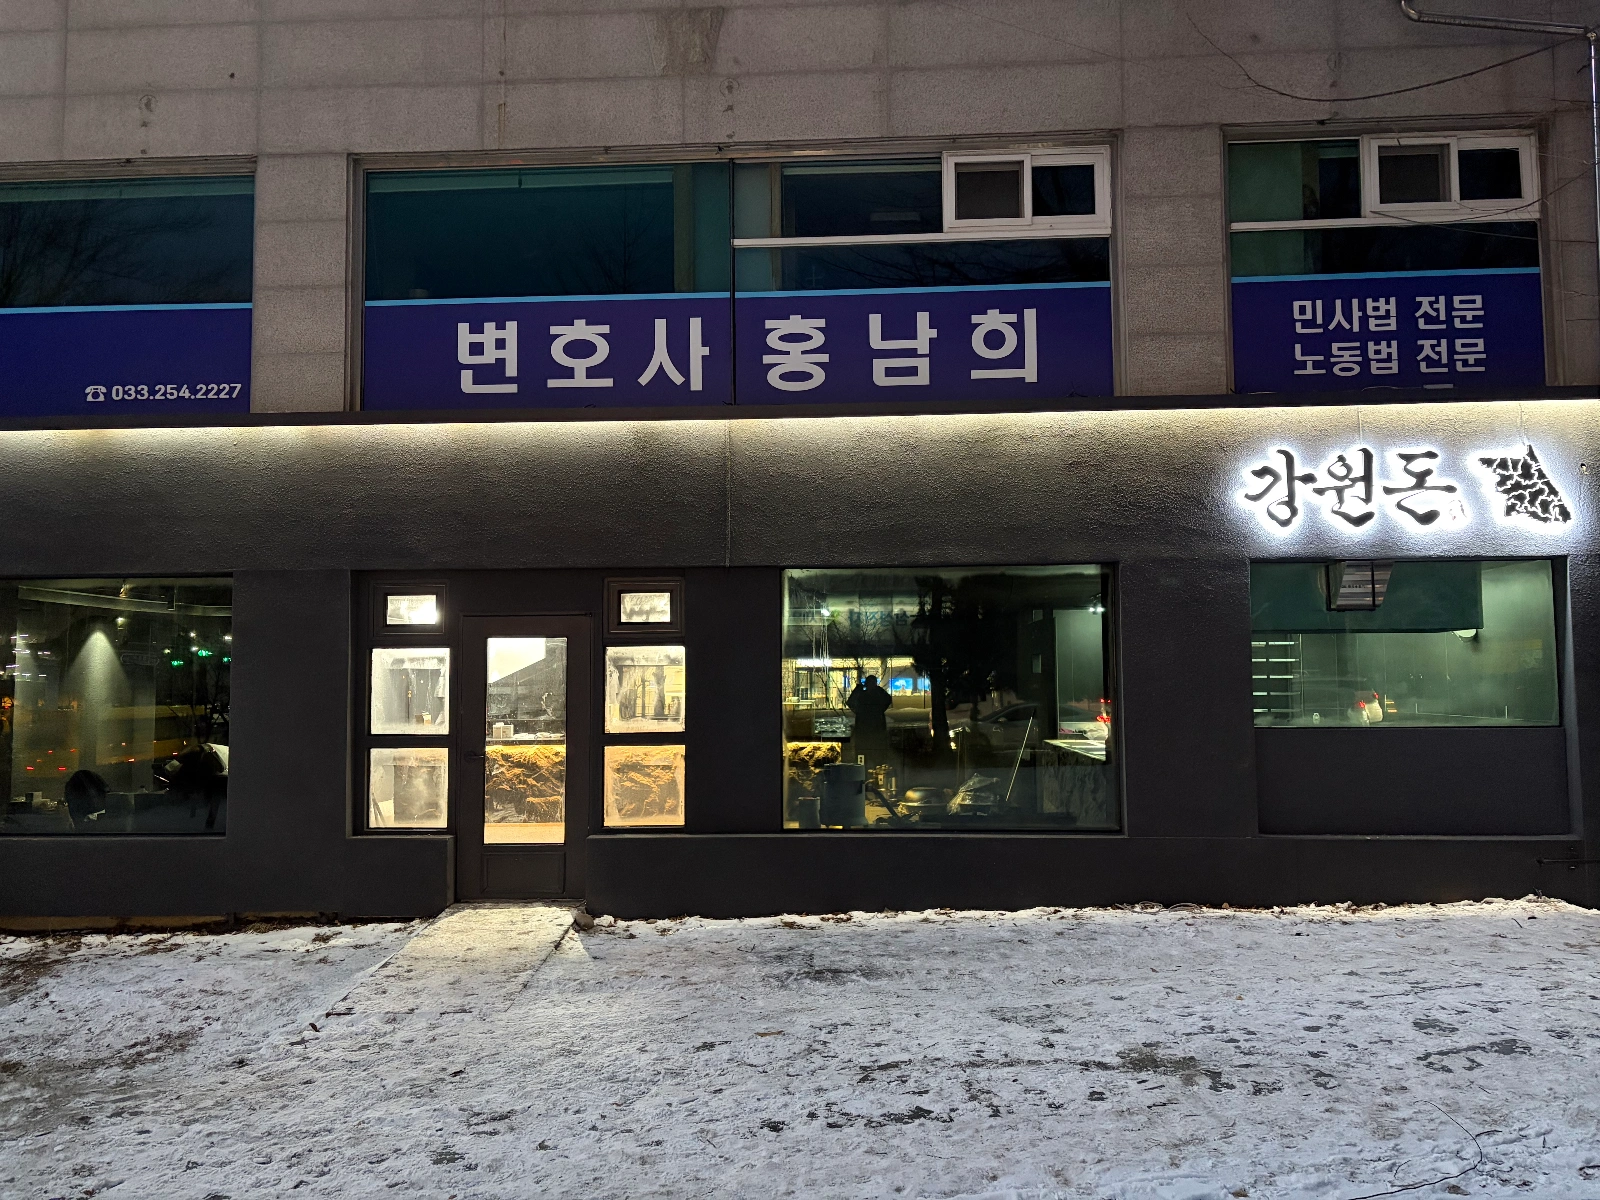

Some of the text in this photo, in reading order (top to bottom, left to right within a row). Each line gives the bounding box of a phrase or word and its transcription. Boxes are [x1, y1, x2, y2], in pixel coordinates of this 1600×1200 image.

[1293, 294, 1485, 333] 민사법 전문
[457, 308, 1038, 394] 변호사 홍남희
[1294, 338, 1487, 376] 노동법 전문
[112, 384, 242, 401] 033.254.2227
[1245, 448, 1457, 527] 강원돈
